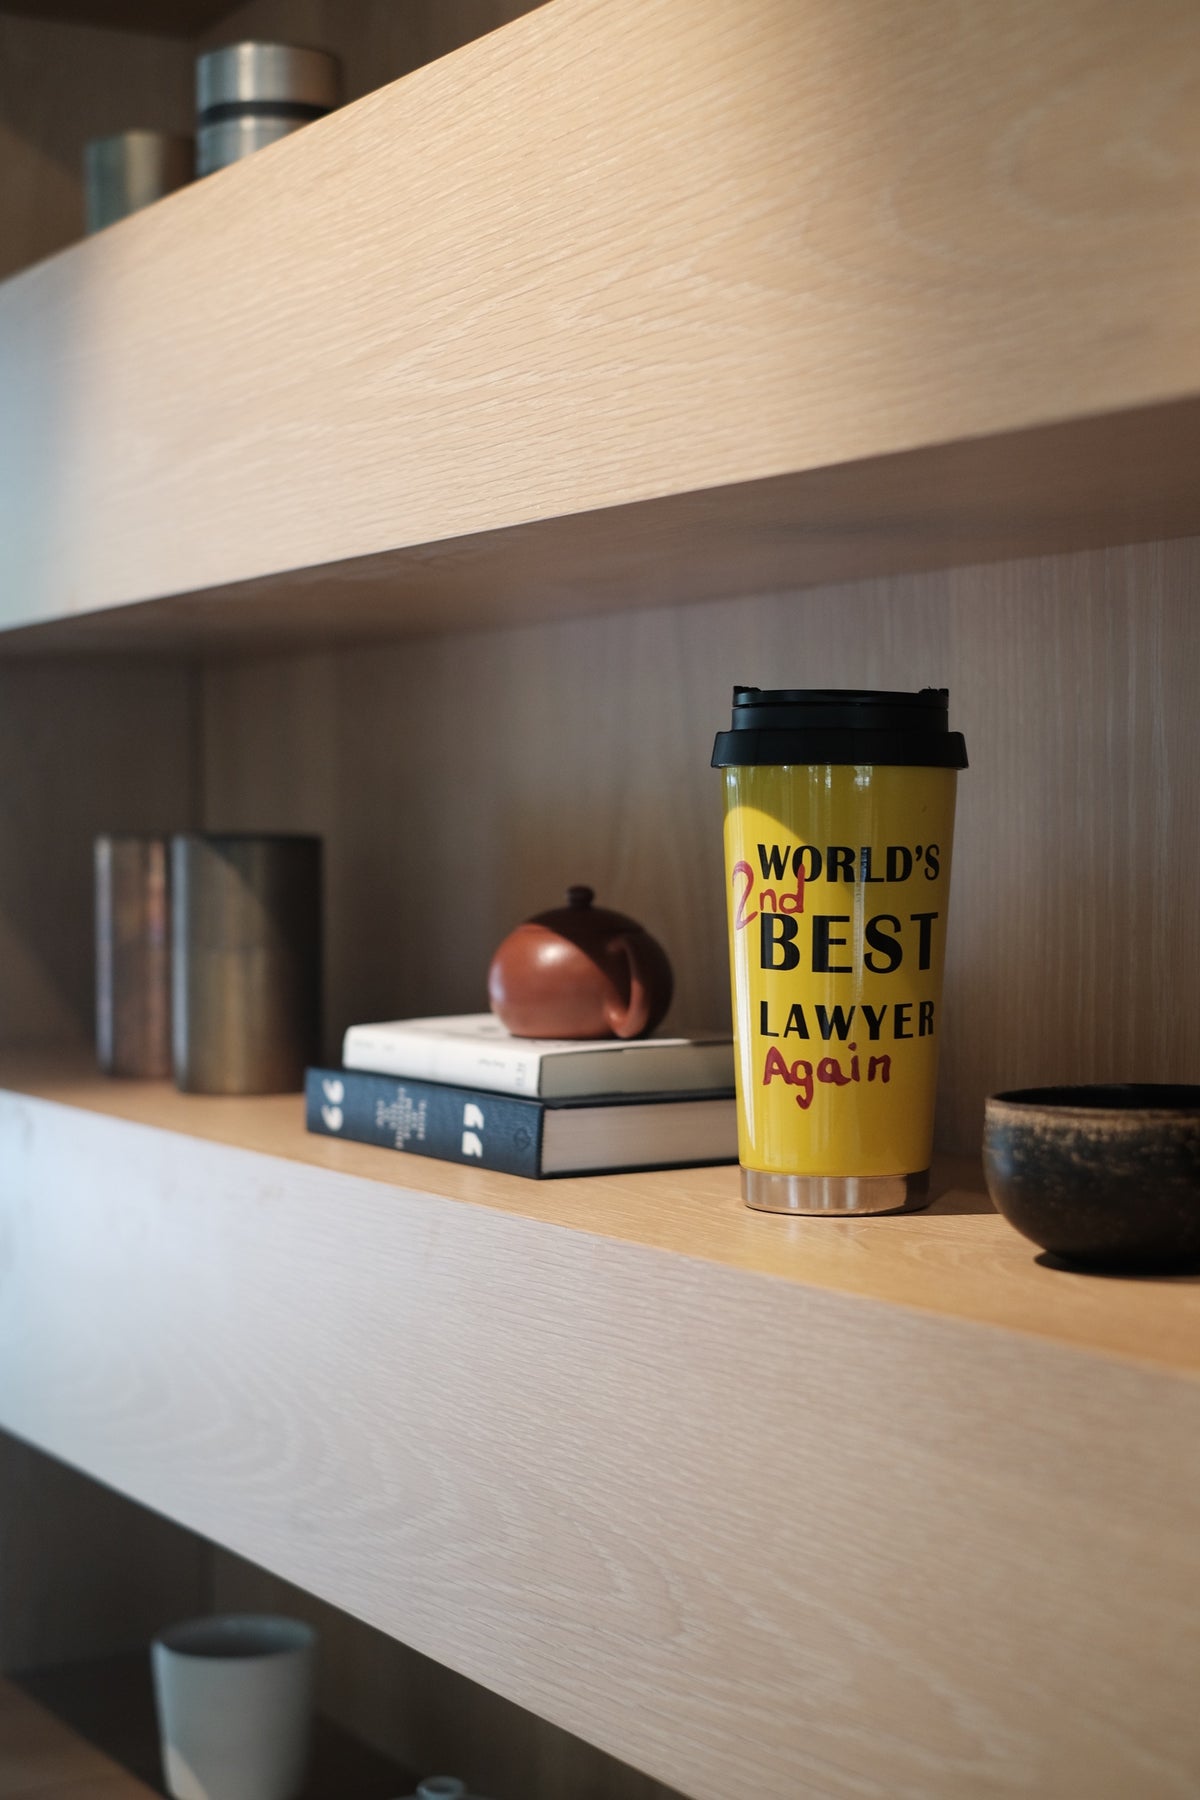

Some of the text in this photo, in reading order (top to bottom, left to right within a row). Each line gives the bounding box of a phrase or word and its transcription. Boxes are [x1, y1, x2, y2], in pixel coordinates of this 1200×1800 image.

[757, 844, 940, 882] WORLD'S
[732, 860, 804, 930] 2nd
[760, 912, 939, 974] BEST
[760, 1000, 935, 1041] LAWYER
[763, 1042, 891, 1110] Again
